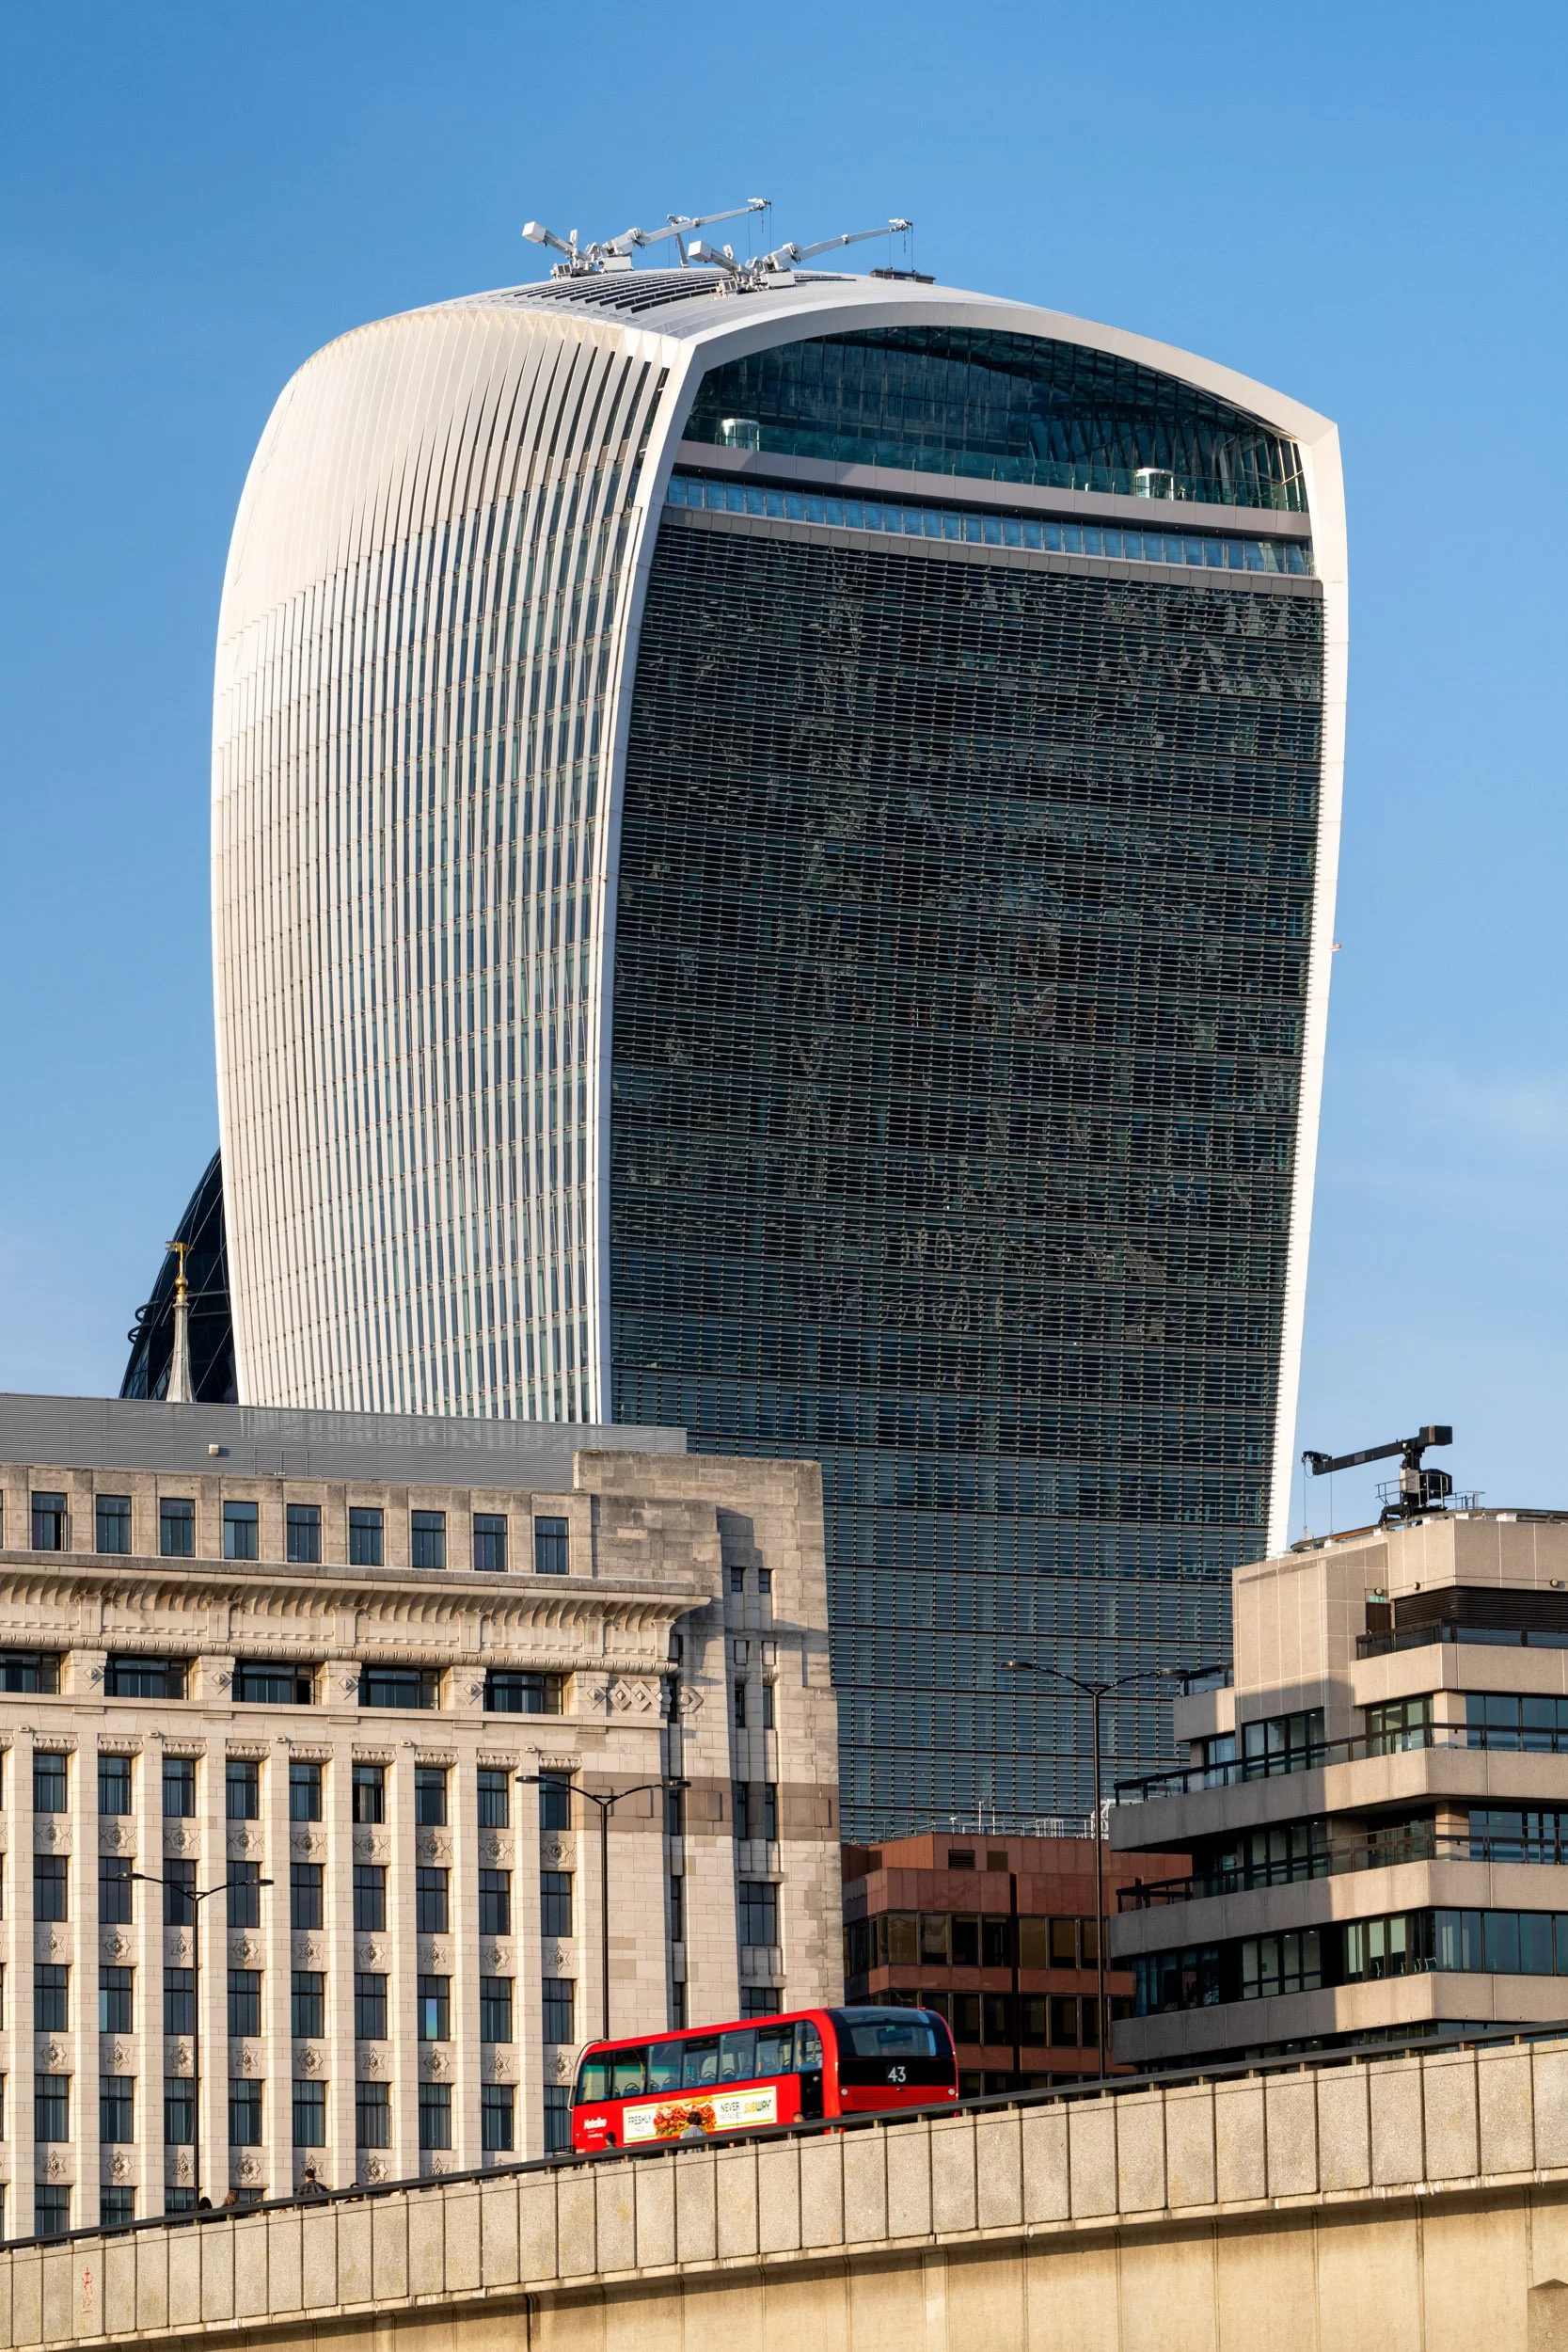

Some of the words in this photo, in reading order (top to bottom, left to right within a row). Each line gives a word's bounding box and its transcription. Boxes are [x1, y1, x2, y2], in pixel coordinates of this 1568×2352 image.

[888, 2066, 906, 2083] 43
[721, 2101, 740, 2113] NEVER
[744, 2099, 771, 2113] SUBWAY
[627, 2114, 652, 2127] FRESHLY
